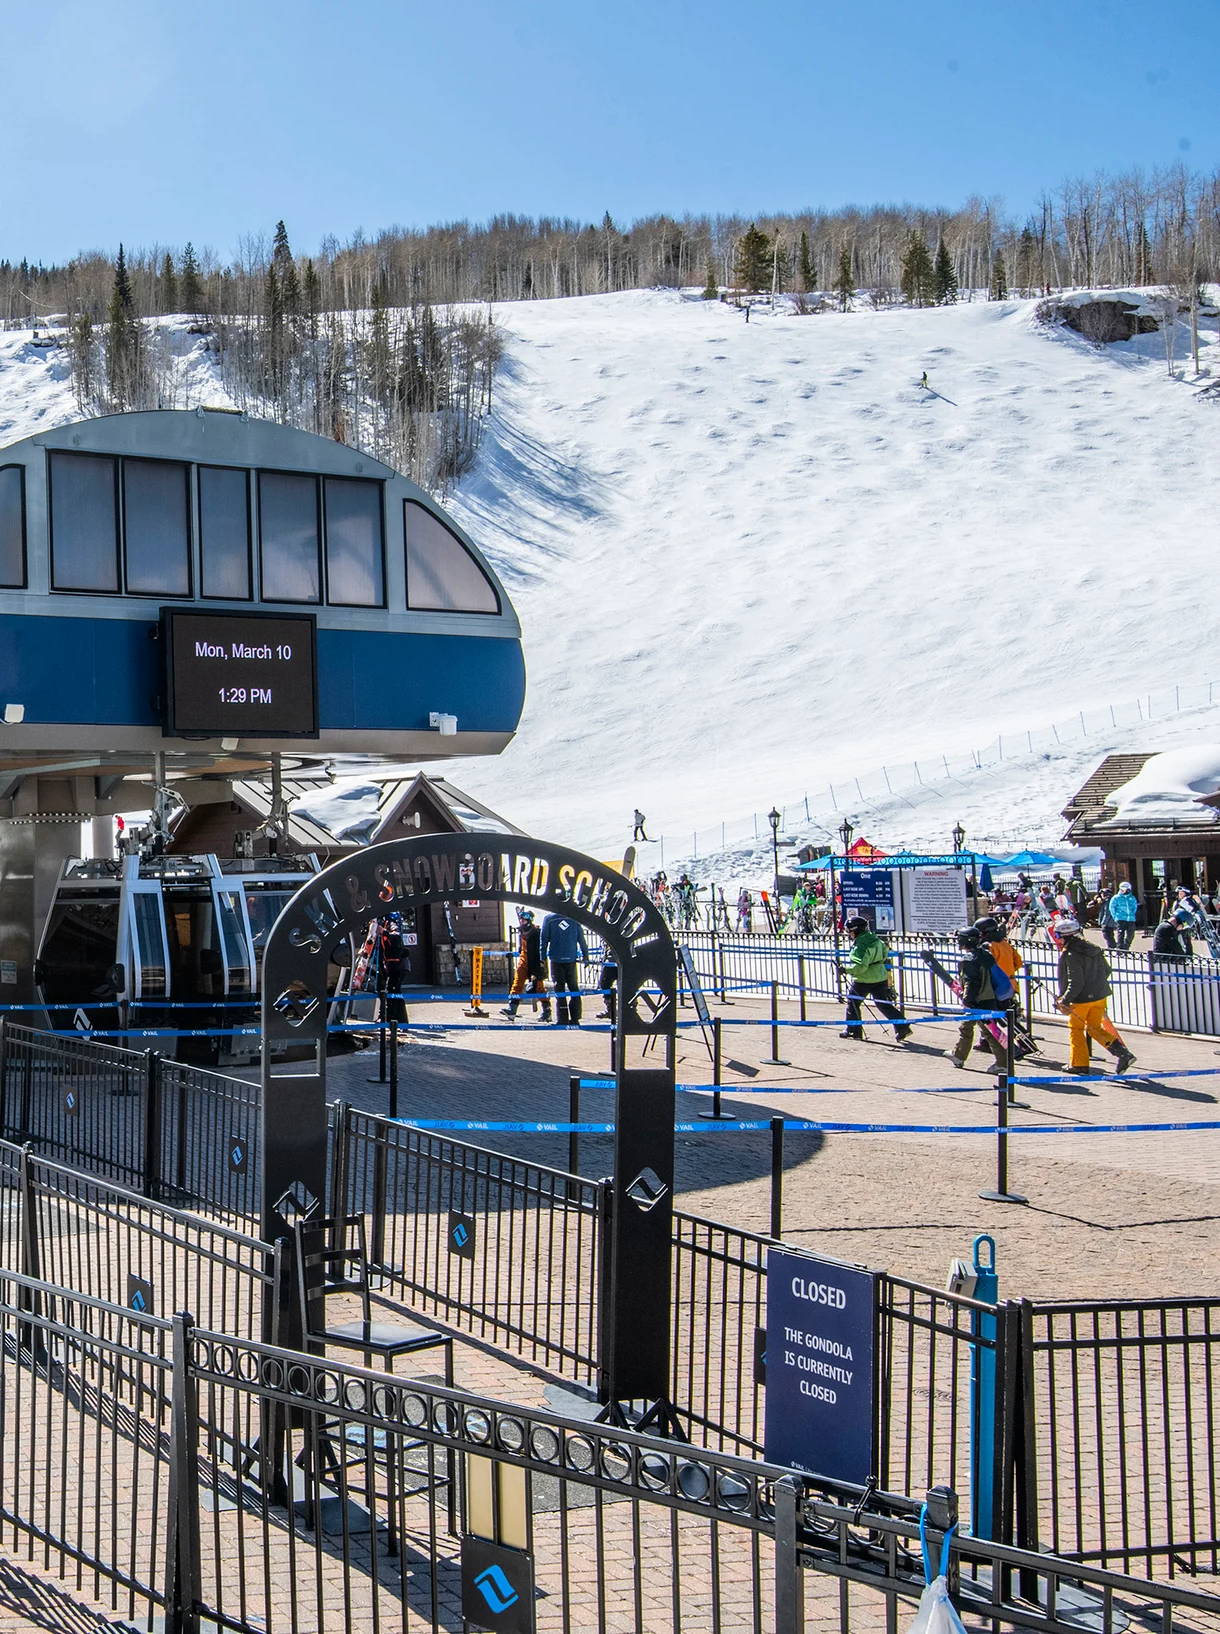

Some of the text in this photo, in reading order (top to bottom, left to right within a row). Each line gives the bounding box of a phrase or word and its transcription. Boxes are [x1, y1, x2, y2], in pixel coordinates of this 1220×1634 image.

[195, 642, 292, 660] Mon, March 10
[218, 687, 272, 704] 1:29 PM
[289, 852, 659, 958] SKI & SNOWBOARD SCHOOL
[791, 1276, 847, 1310] CLOSED
[784, 1326, 853, 1361] THE GONDOLA
[785, 1351, 853, 1385] IS CURRENTLY
[800, 1380, 837, 1404] CLOSED
